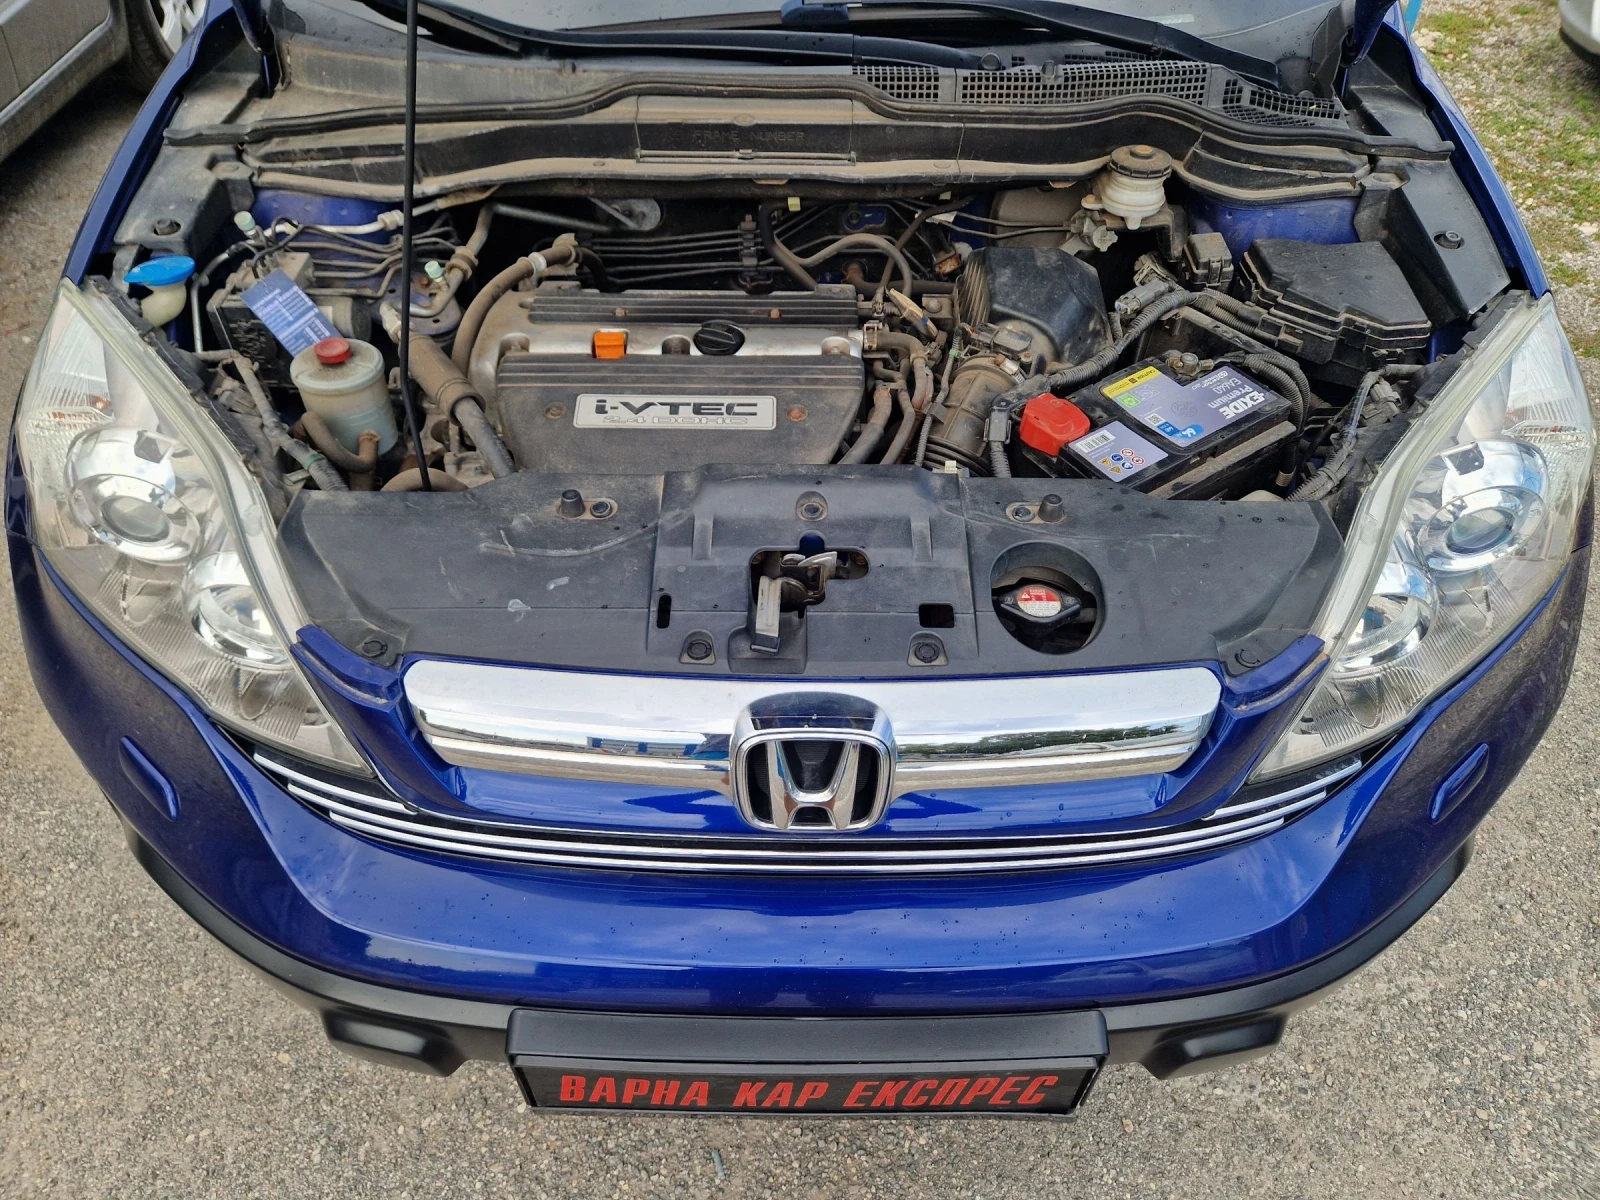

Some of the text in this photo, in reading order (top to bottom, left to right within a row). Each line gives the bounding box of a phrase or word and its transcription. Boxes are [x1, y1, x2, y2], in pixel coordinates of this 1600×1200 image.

[693, 131, 806, 142] FRAME NUMBER
[1212, 377, 1242, 394] EA640
[1207, 384, 1254, 409] Premium
[1218, 390, 1266, 419] EXIDE
[595, 399, 758, 416] i-VTEC
[602, 416, 748, 425] 2.4 DOHC
[559, 1075, 1059, 1107] ВАРНА КАР ЕКСПРЕС
